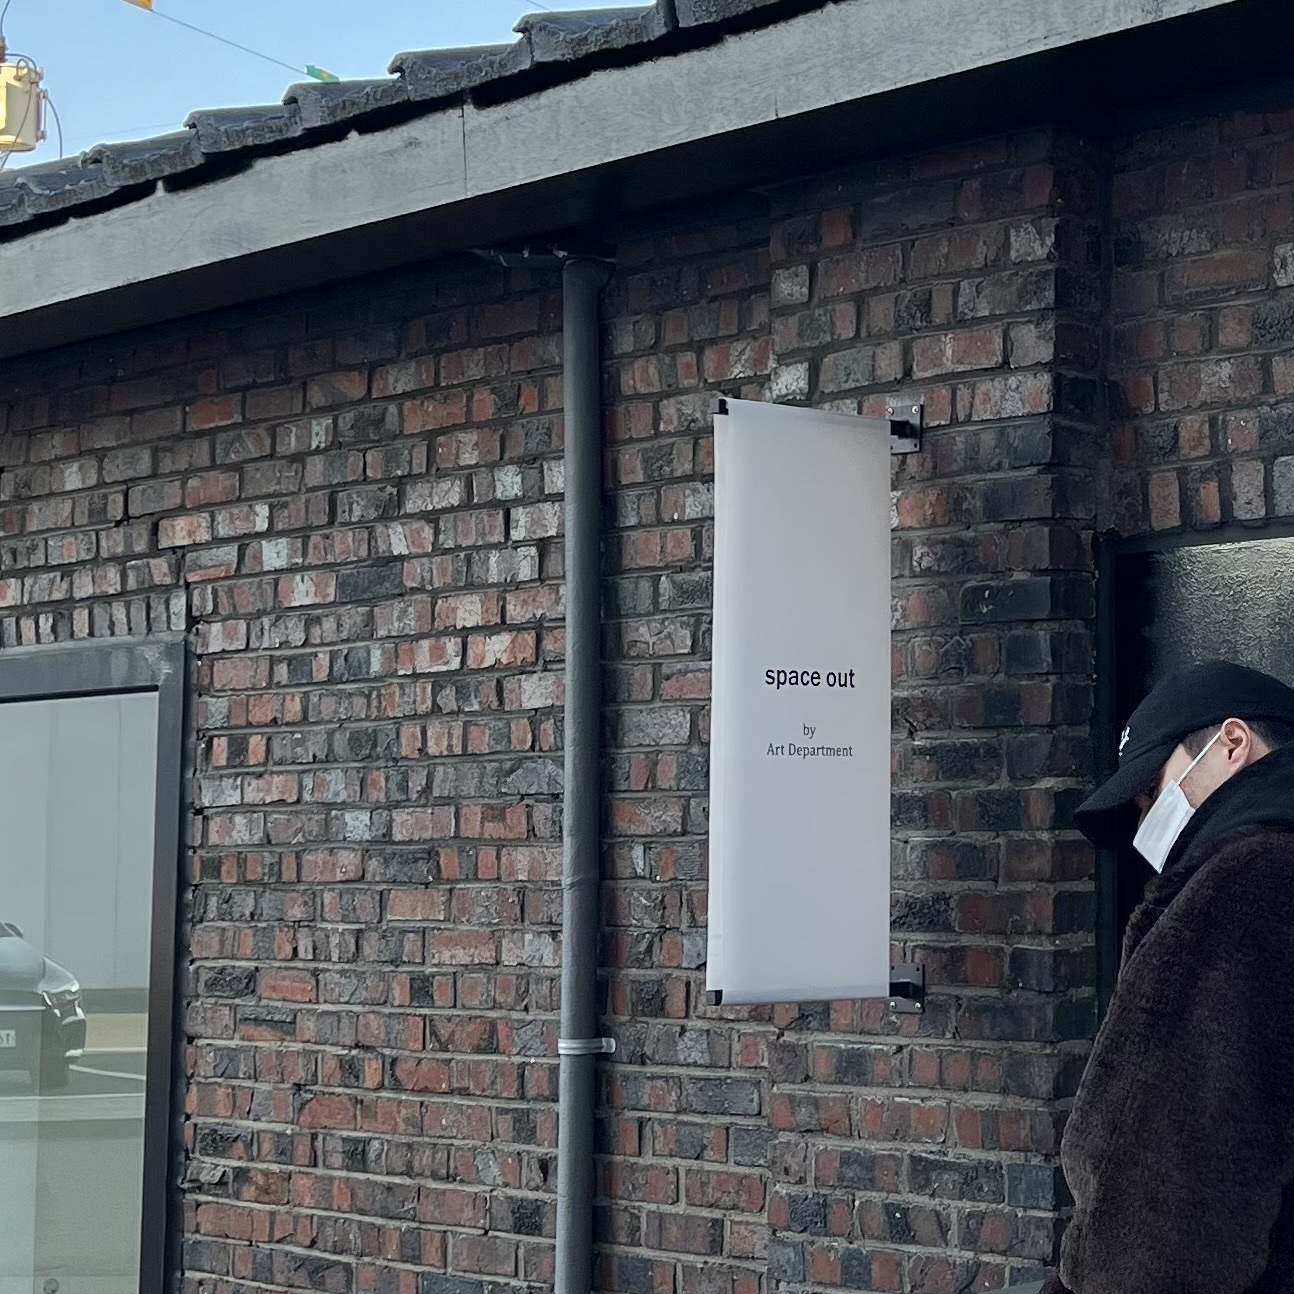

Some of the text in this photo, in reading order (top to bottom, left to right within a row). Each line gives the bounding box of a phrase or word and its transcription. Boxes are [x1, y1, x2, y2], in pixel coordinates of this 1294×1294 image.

[765, 668, 855, 690] space out
[803, 723, 816, 739] by
[766, 743, 853, 759] Art Department
